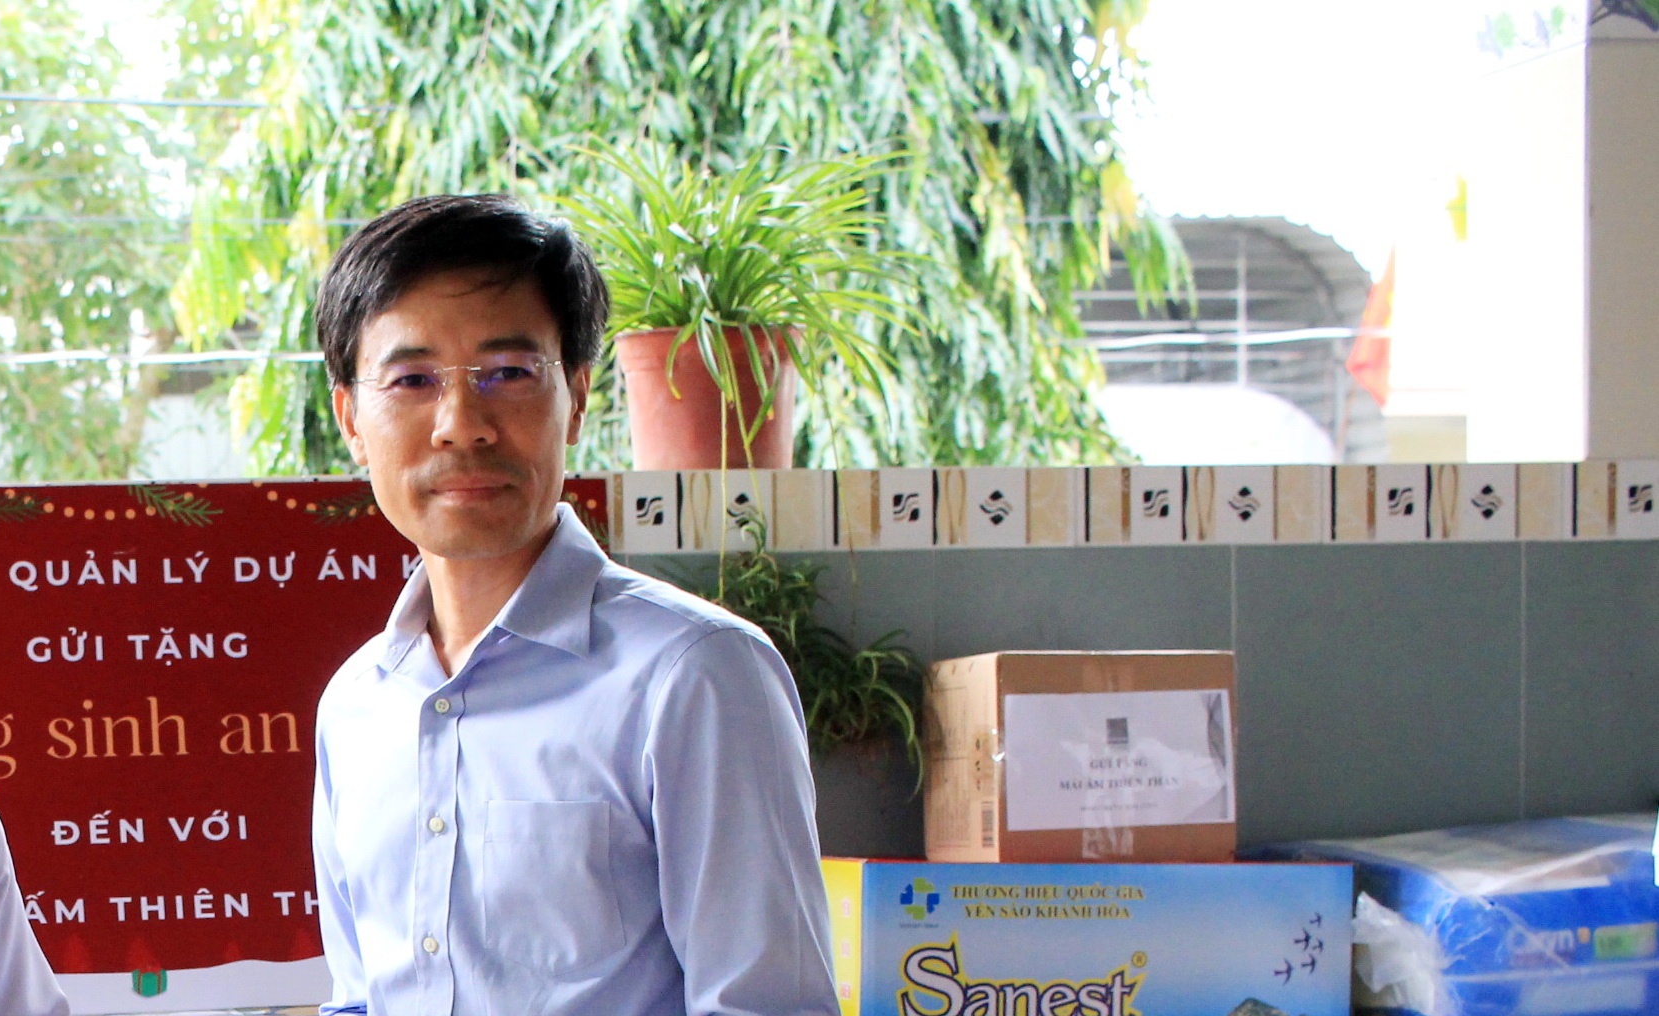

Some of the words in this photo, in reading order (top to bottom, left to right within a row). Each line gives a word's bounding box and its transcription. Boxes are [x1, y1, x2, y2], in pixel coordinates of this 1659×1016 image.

[9, 551, 138, 591] QUẢN
[163, 551, 210, 584] LÝ
[235, 551, 295, 587] DỰ
[317, 549, 377, 580] ÁN
[27, 627, 104, 662] GỬI
[127, 627, 248, 666] TẶNG
[47, 696, 189, 759] sinh
[220, 711, 300, 754] an
[51, 810, 145, 845] ĐẾN
[168, 810, 248, 841] VỚI
[110, 888, 250, 921] THIÊN
[1066, 882, 1113, 900] QUỐC
[1116, 885, 1145, 899] GIA
